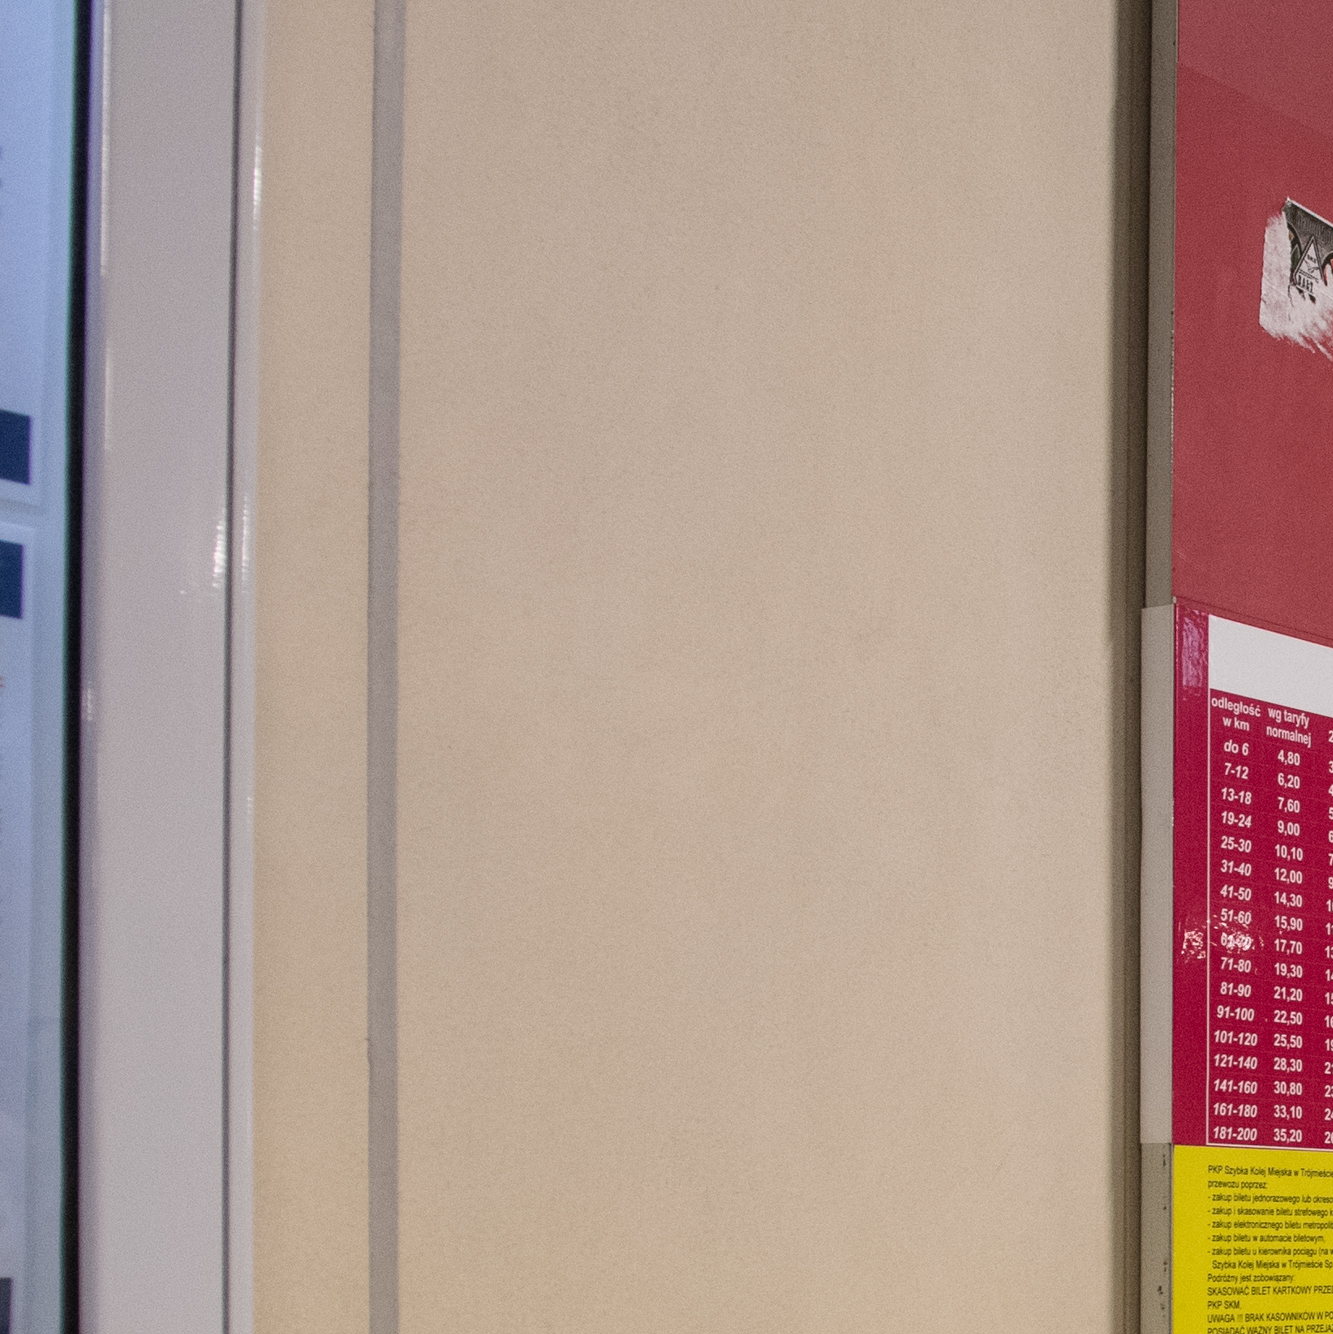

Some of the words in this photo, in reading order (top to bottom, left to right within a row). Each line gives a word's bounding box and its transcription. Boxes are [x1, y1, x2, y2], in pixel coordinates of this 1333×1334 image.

[1210, 696, 1260, 716] odległość
[1222, 717, 1231, 726] w
[1233, 717, 1249, 730] km
[1267, 707, 1281, 722] wg
[1283, 709, 1309, 729] taryfy
[1266, 725, 1311, 748] normalnej
[1223, 739, 1238, 753] do
[1241, 742, 1248, 755] 6
[1277, 749, 1300, 765] 4,80
[1224, 762, 1248, 779] 7-12
[1277, 772, 1300, 788] 6,20
[1221, 787, 1251, 804] 13-18
[1221, 811, 1251, 827] 19-24
[1214, 1029, 1257, 1046] 101-120
[1211, 1126, 1257, 1144] 181-200
[1273, 1127, 1302, 1142] 35,20
